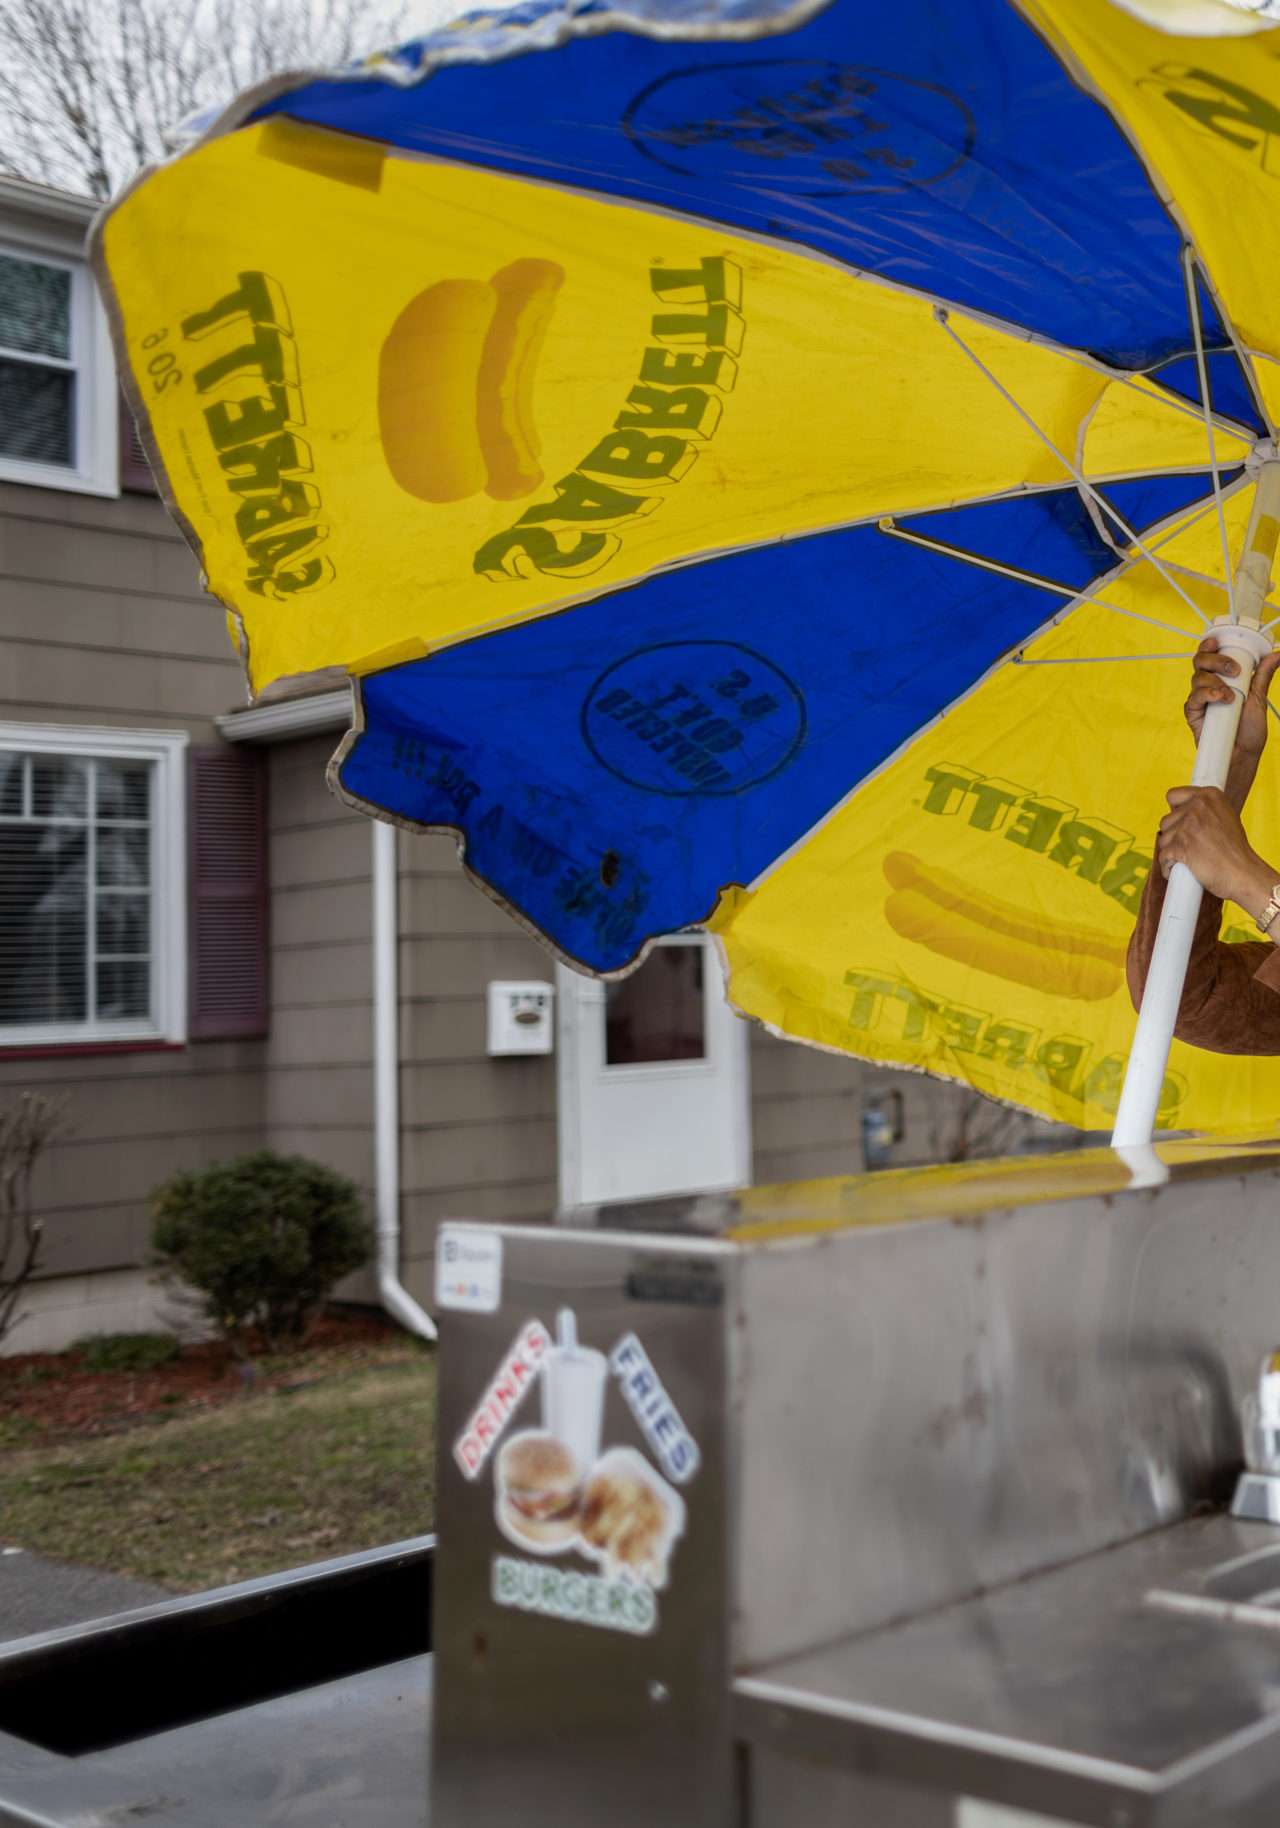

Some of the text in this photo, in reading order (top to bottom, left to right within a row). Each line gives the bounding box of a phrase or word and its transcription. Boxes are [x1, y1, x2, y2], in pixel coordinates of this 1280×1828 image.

[460, 1331, 548, 1471] DRINKS
[615, 1346, 692, 1473] FRIES
[498, 1564, 654, 1623] BURGERS
